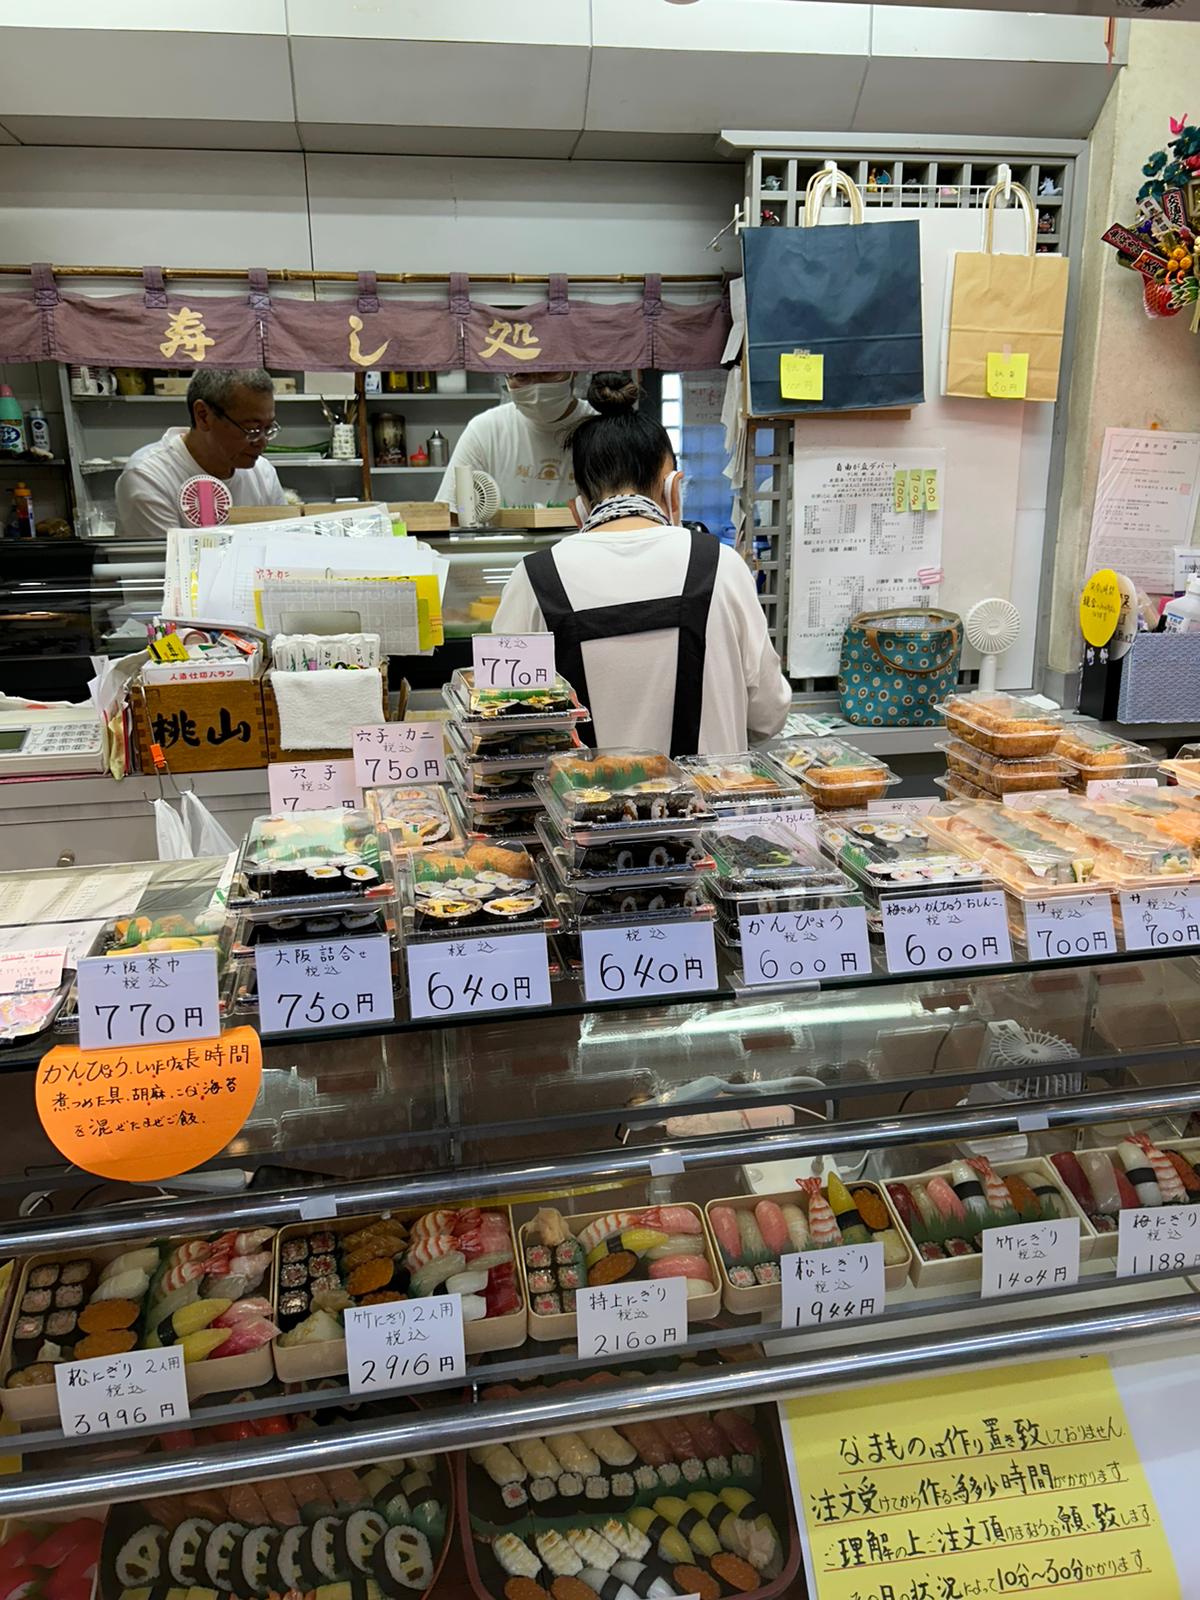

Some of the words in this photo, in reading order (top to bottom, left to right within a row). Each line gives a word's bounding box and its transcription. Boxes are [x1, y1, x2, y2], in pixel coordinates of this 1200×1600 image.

[498, 637, 529, 649] 税込
[481, 657, 547, 687] 770円
[153, 707, 252, 748] 桃山
[383, 742, 414, 754] 税込
[289, 764, 337, 781] 穴子
[365, 758, 440, 783] 750円
[299, 781, 333, 793] 税込
[1036, 896, 1095, 914] サバ
[1050, 907, 1086, 921] 税込
[1147, 897, 1178, 911] 税込
[747, 910, 845, 936] かんぴょう
[926, 914, 963, 926] 税込
[625, 927, 668, 942] 税込
[784, 930, 818, 943] 税込
[1036, 930, 1108, 958] 700円
[1145, 923, 1200, 947] 700円
[448, 940, 498, 957] 税込
[905, 933, 999, 966] 600円
[103, 956, 181, 976] 大阪茶巾
[304, 965, 342, 977] 税込
[599, 952, 704, 992] 640円
[759, 949, 858, 979] 600円
[122, 976, 170, 990] 税込
[427, 971, 531, 1010] 640円
[277, 991, 374, 1028] 750円
[95, 1003, 204, 1040] 770円
[996, 1228, 1059, 1252] 竹にぎり
[1147, 1228, 1184, 1242] 税込
[1018, 1248, 1047, 1260] 税込
[794, 1249, 870, 1281] 松にぎり
[814, 1278, 854, 1293] 税込
[997, 1266, 1067, 1289] 1404円
[589, 1285, 667, 1311] 特上にぎり
[616, 1308, 649, 1321] 税込
[795, 1297, 875, 1327] 1944円
[385, 1326, 430, 1346] 税込
[594, 1327, 678, 1356] 2160円
[361, 1352, 455, 1385] 2916円
[104, 1382, 148, 1398] 税込
[74, 1402, 175, 1435] 3996円
